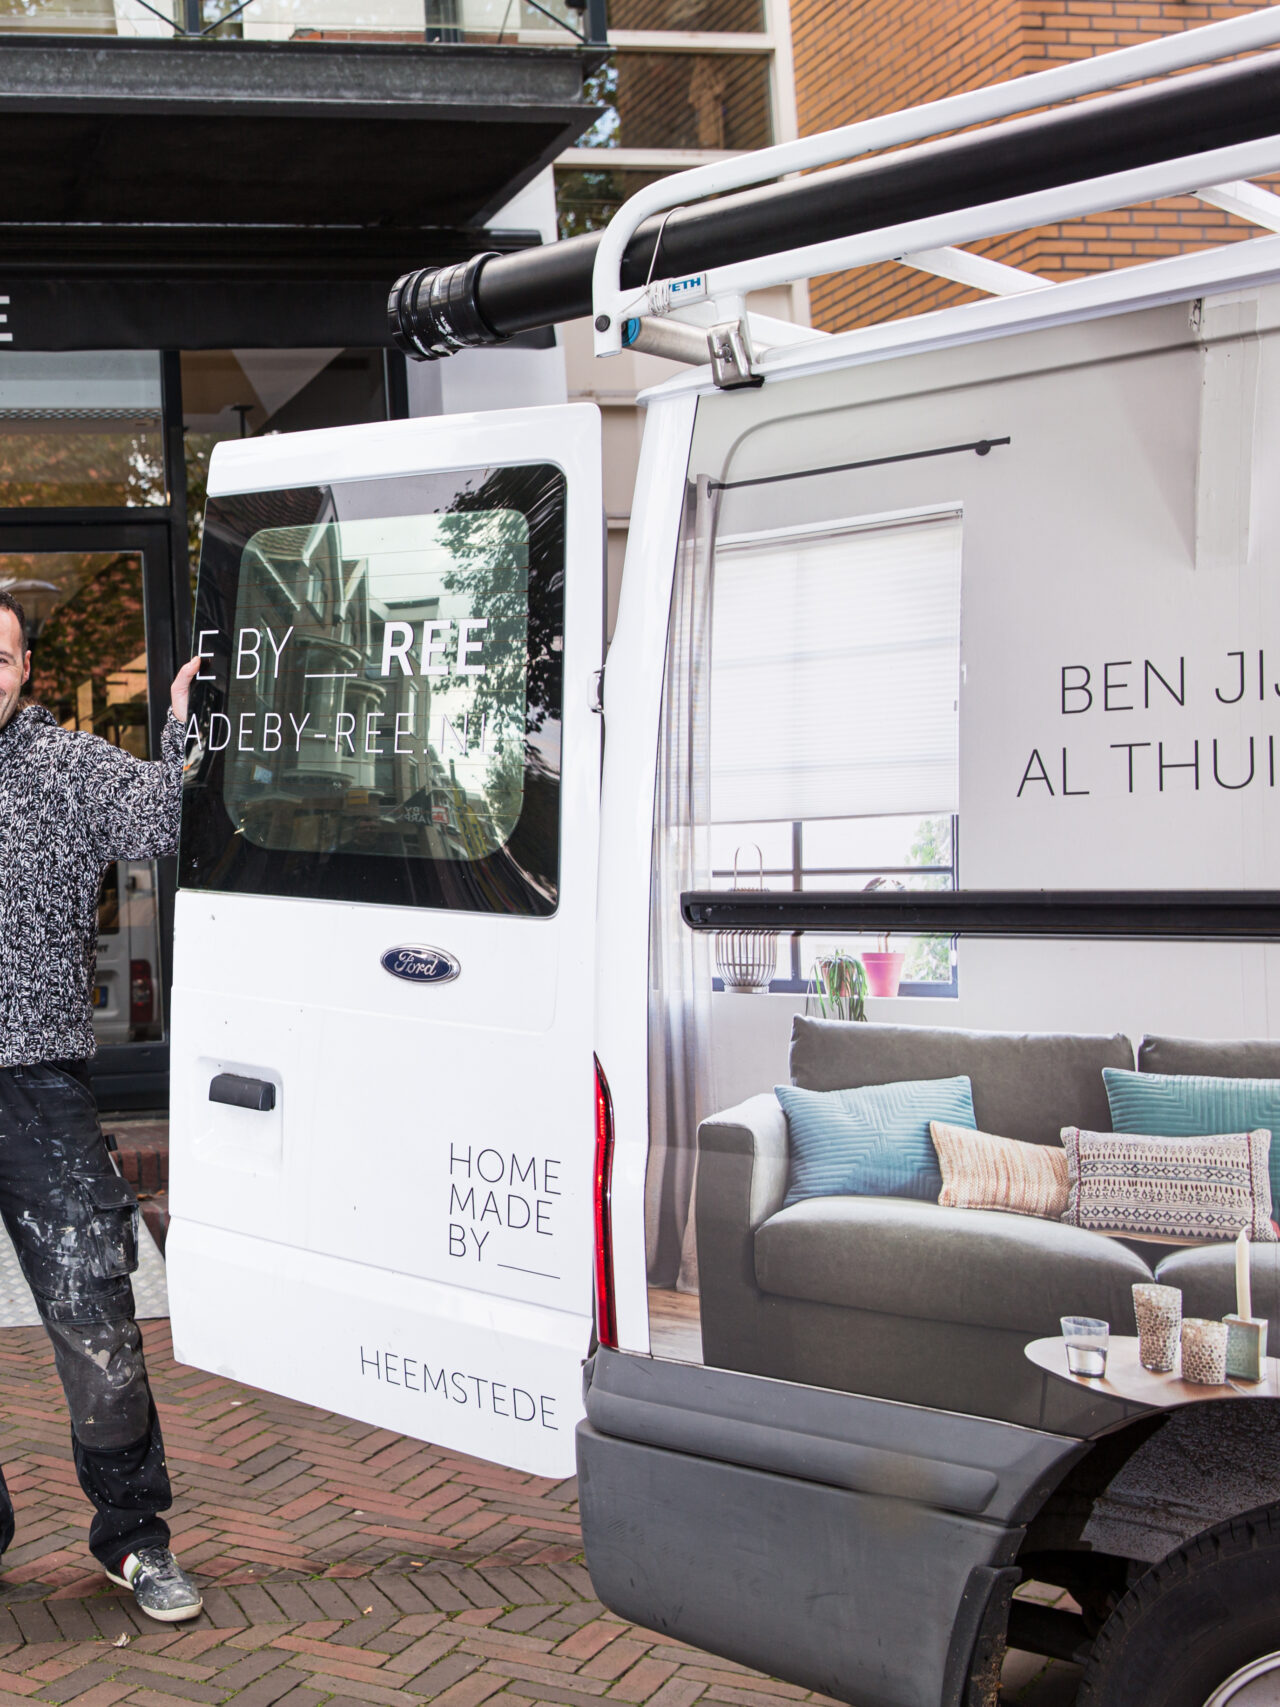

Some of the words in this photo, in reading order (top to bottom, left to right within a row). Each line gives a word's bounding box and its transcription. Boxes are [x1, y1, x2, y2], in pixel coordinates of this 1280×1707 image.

[236, 626, 294, 680] BY
[380, 618, 488, 677] REE
[1061, 656, 1184, 714] BEN
[1215, 650, 1280, 704] JI
[1016, 747, 1090, 798] AL
[1109, 735, 1274, 794] THUI
[393, 951, 439, 976] Ford
[449, 1142, 562, 1195] HOME
[449, 1183, 554, 1236] MADE
[448, 1223, 490, 1263] BY
[360, 1345, 559, 1430] HEEMSTEDE
